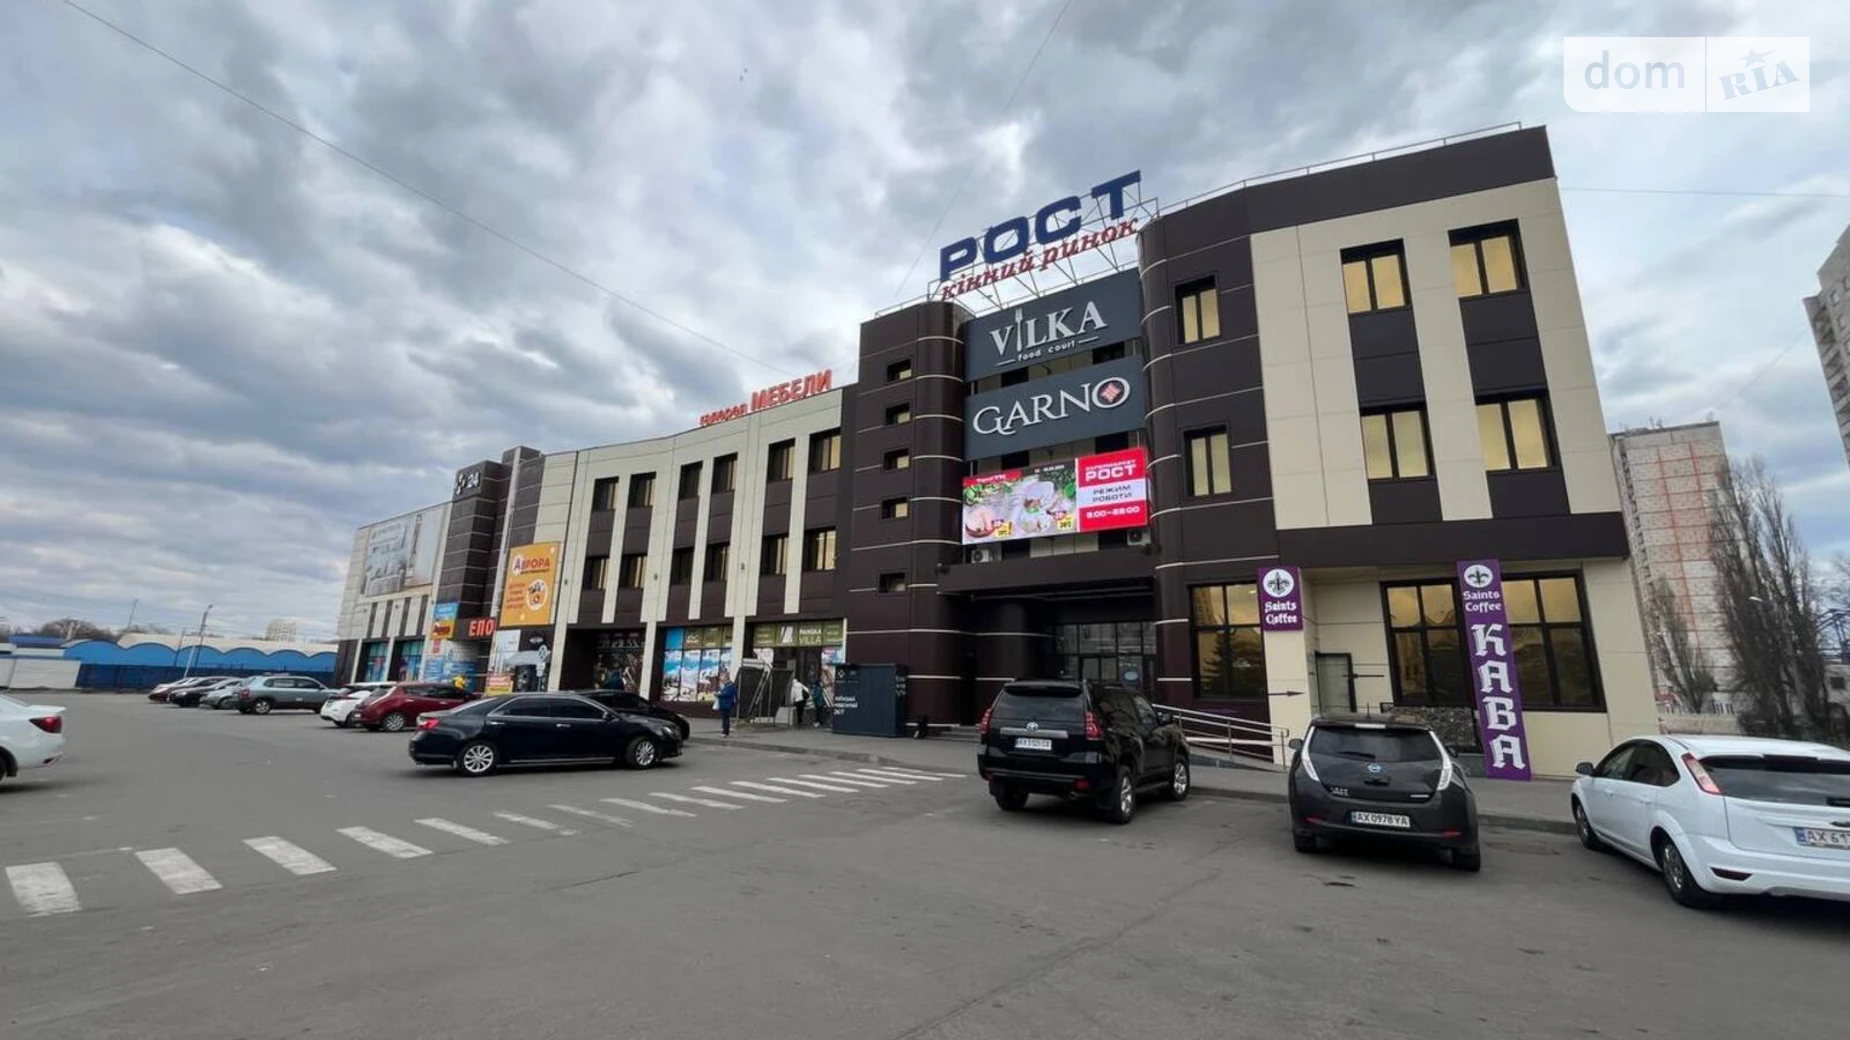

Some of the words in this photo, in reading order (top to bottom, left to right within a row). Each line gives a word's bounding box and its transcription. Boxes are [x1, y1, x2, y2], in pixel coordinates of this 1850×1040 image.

[939, 169, 1142, 282] РОСТ
[1039, 217, 1139, 272] ринок
[990, 301, 1108, 356] VILKA
[1018, 349, 1041, 361] food
[1047, 339, 1075, 353] court
[751, 369, 832, 411] МЕБЕЛИ
[973, 376, 1131, 436] GARNO
[1085, 464, 1136, 482] РОСТ
[1463, 590, 1500, 600] Saints
[1265, 601, 1297, 613] Saints
[1465, 602, 1502, 613] Coffee
[1266, 613, 1297, 625] Coffee
[1471, 624, 1526, 769] КАВА
[1807, 830, 1829, 843] AX
